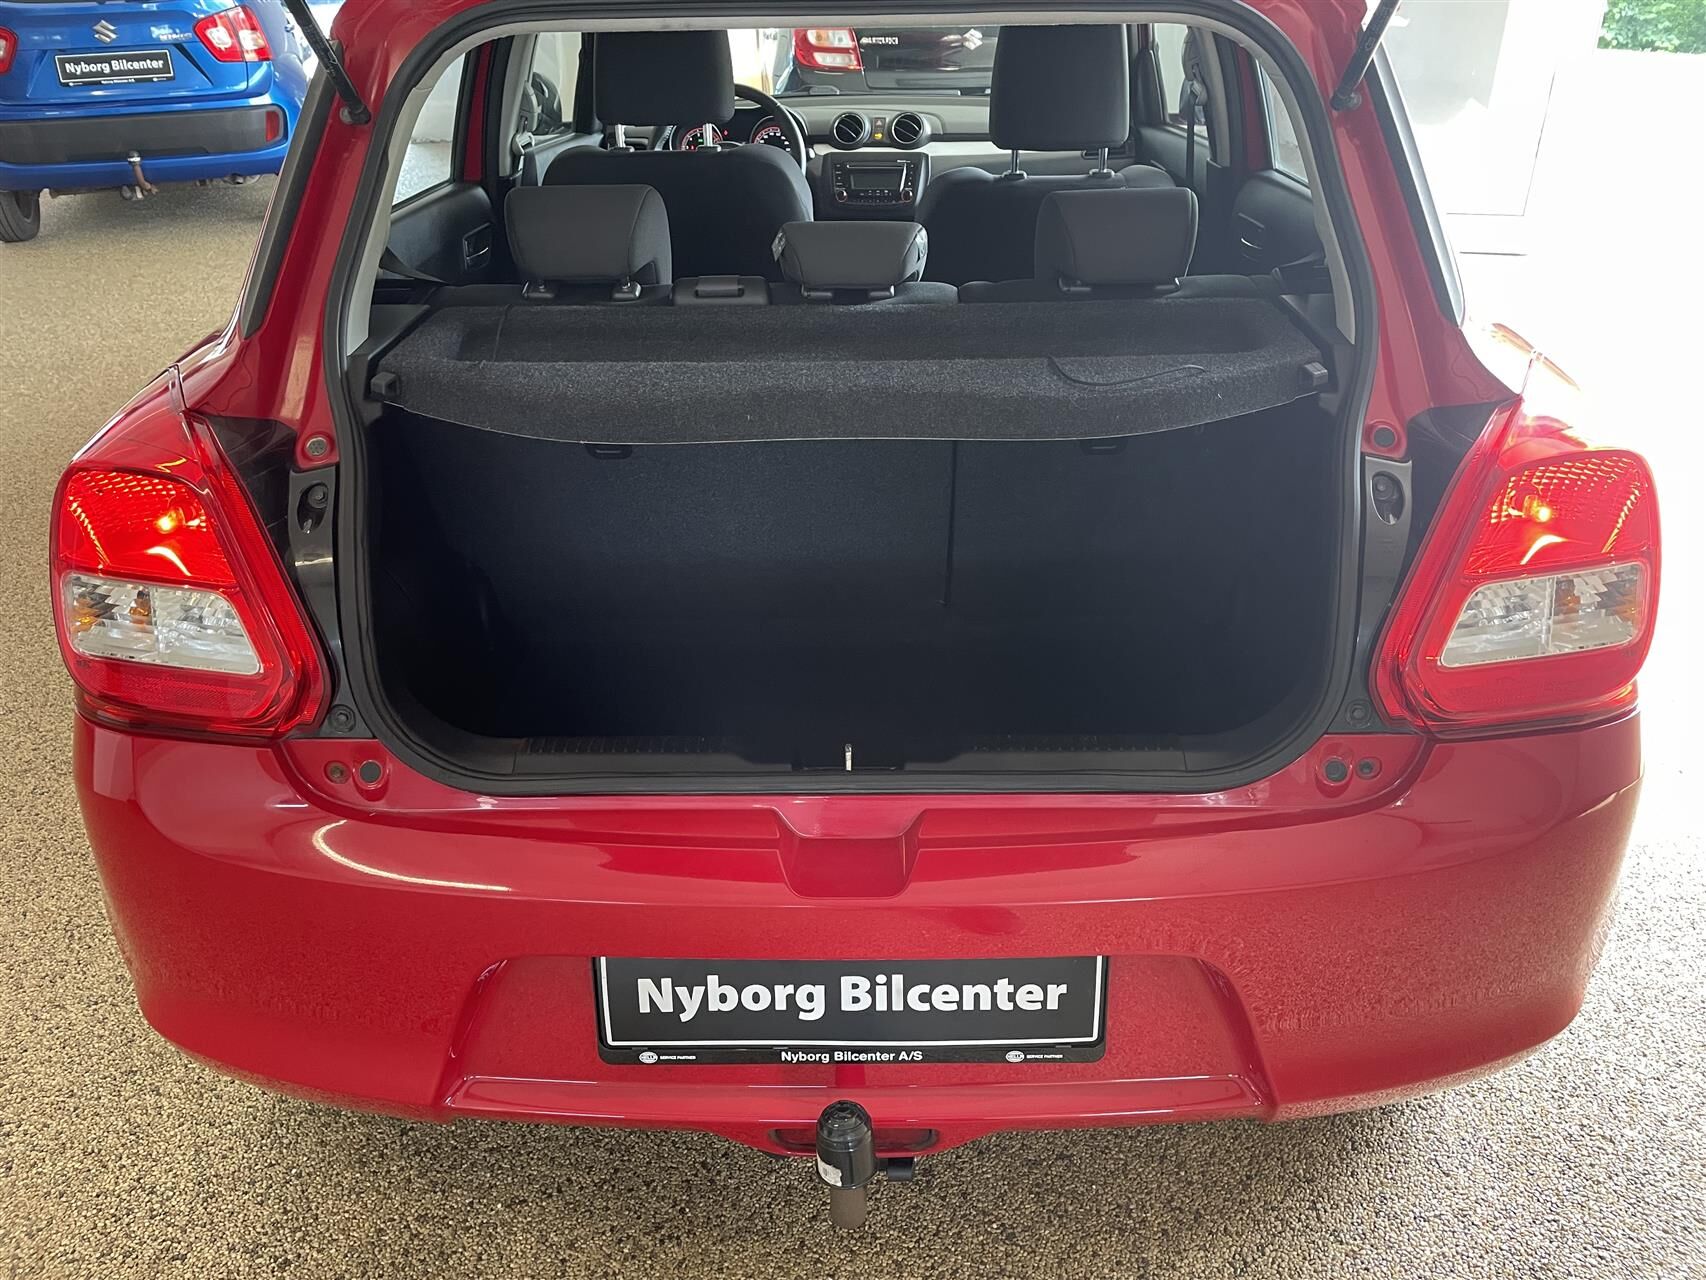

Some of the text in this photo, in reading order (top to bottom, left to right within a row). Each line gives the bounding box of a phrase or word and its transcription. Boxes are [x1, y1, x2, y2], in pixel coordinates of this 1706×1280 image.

[64, 59, 164, 75] Nyborg Bilcenter
[637, 974, 1067, 1023] Nyborg Bilcenter
[781, 1051, 923, 1064] Nyborg Bilcenter A/S
